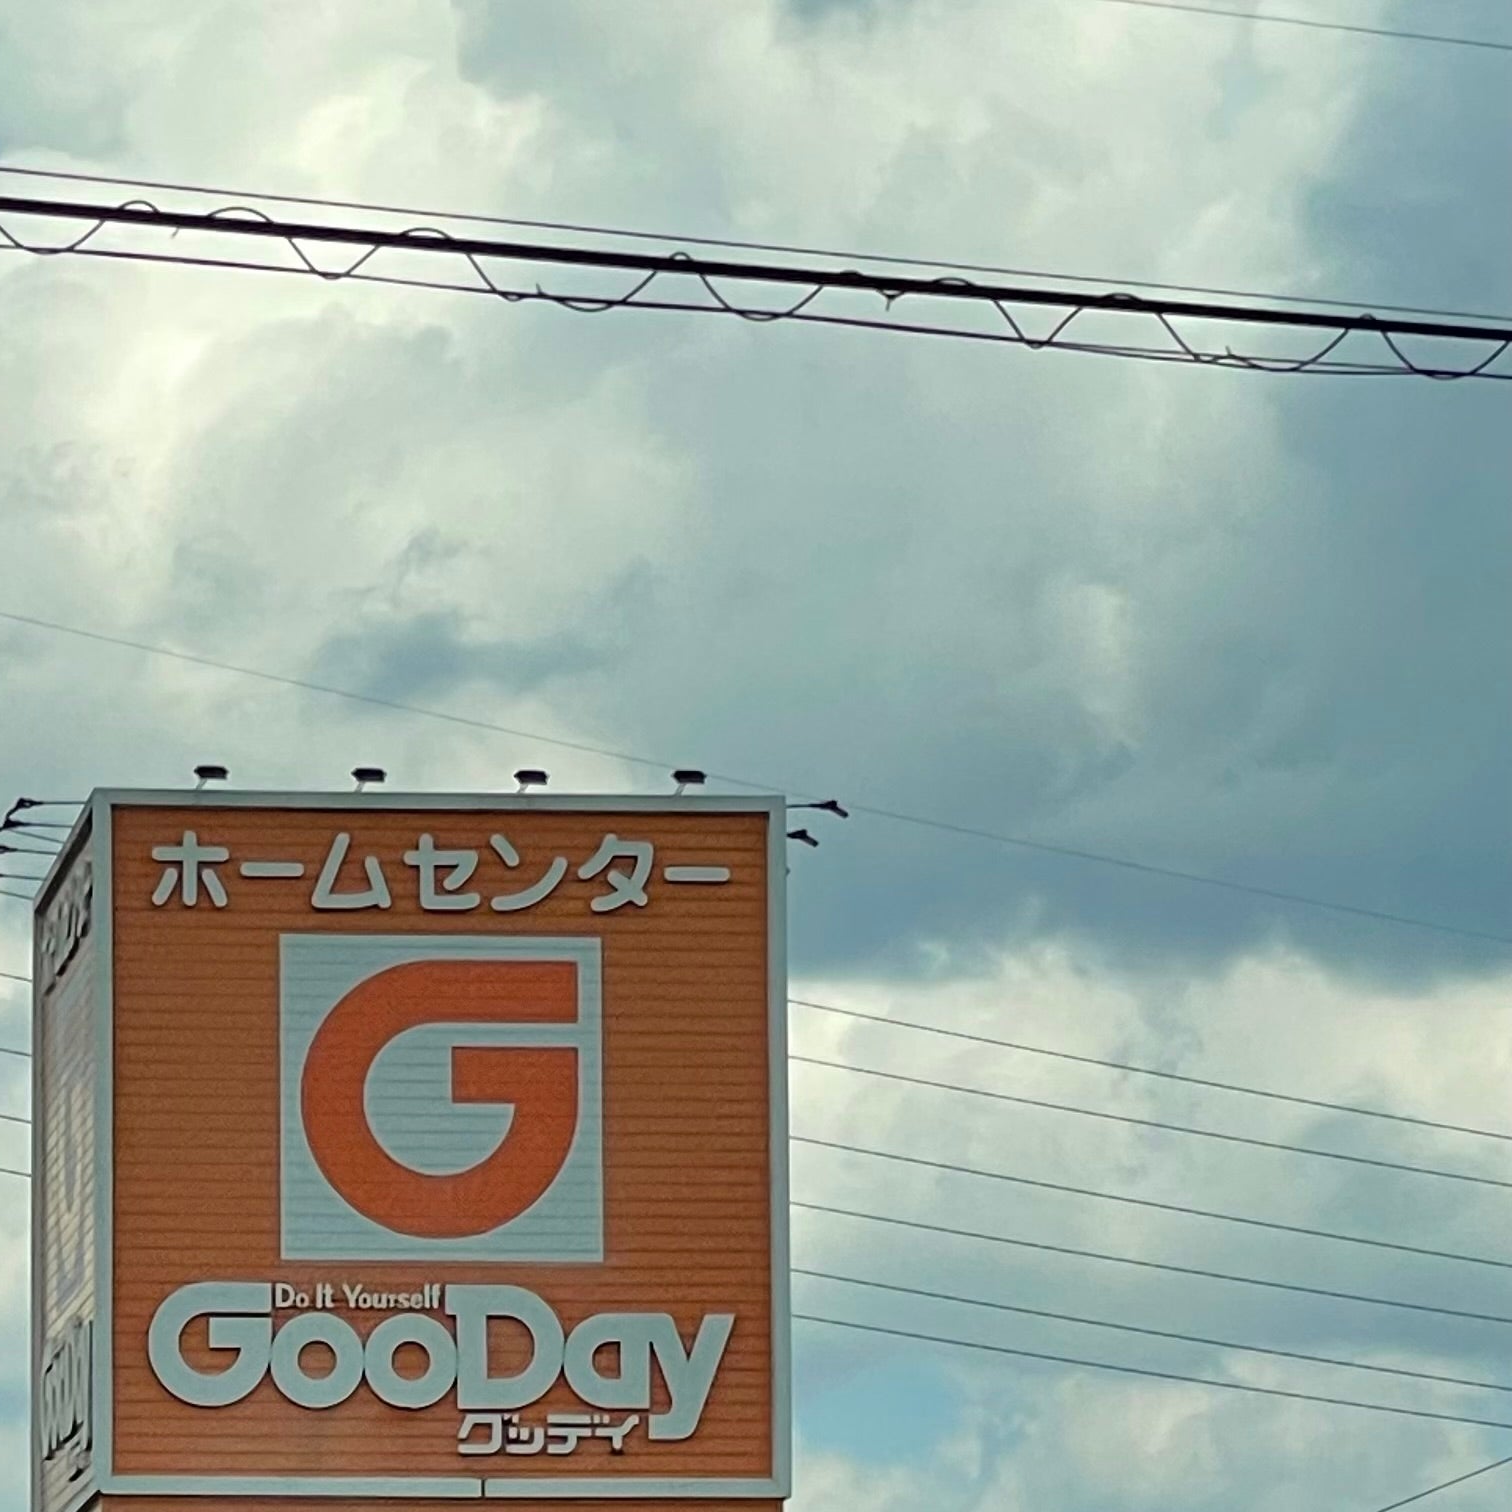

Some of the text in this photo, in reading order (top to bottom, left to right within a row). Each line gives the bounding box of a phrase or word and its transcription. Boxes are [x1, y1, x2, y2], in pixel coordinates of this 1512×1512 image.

[151, 829, 732, 914] ホームセンター
[300, 959, 580, 1240] G
[274, 1282, 441, 1310] Do It Yourself
[147, 1281, 736, 1440] GooDay
